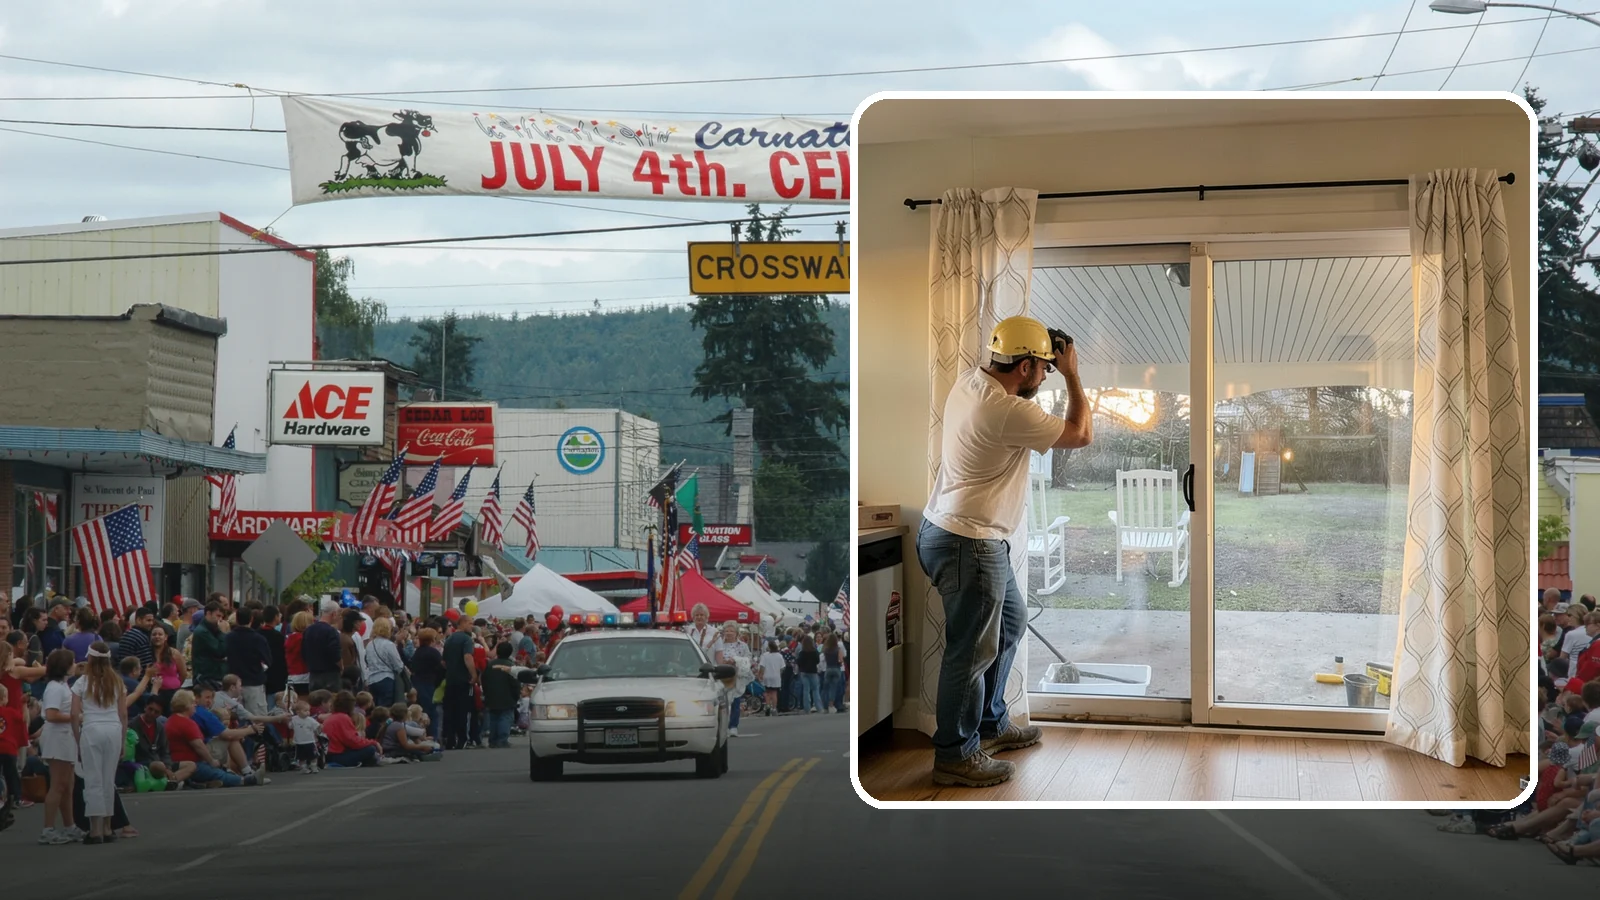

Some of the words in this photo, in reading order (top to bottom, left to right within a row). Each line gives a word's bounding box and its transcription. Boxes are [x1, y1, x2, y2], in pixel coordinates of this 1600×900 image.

[481, 141, 605, 192] JULY
[632, 150, 746, 198] 4th.
[697, 254, 850, 280] CROSSWA
[283, 380, 373, 420] ACE
[406, 409, 452, 421] CEDAR
[283, 421, 370, 436] Hardware
[416, 428, 477, 446] Coca-Cola
[353, 467, 386, 481] Simpl
[83, 485, 93, 494] St.
[96, 485, 124, 494] Vincent
[126, 486, 135, 494] de
[138, 486, 155, 495] Paul
[81, 503, 153, 522] THT
[688, 526, 741, 535] CRNATION
[699, 535, 730, 543] GLASS
